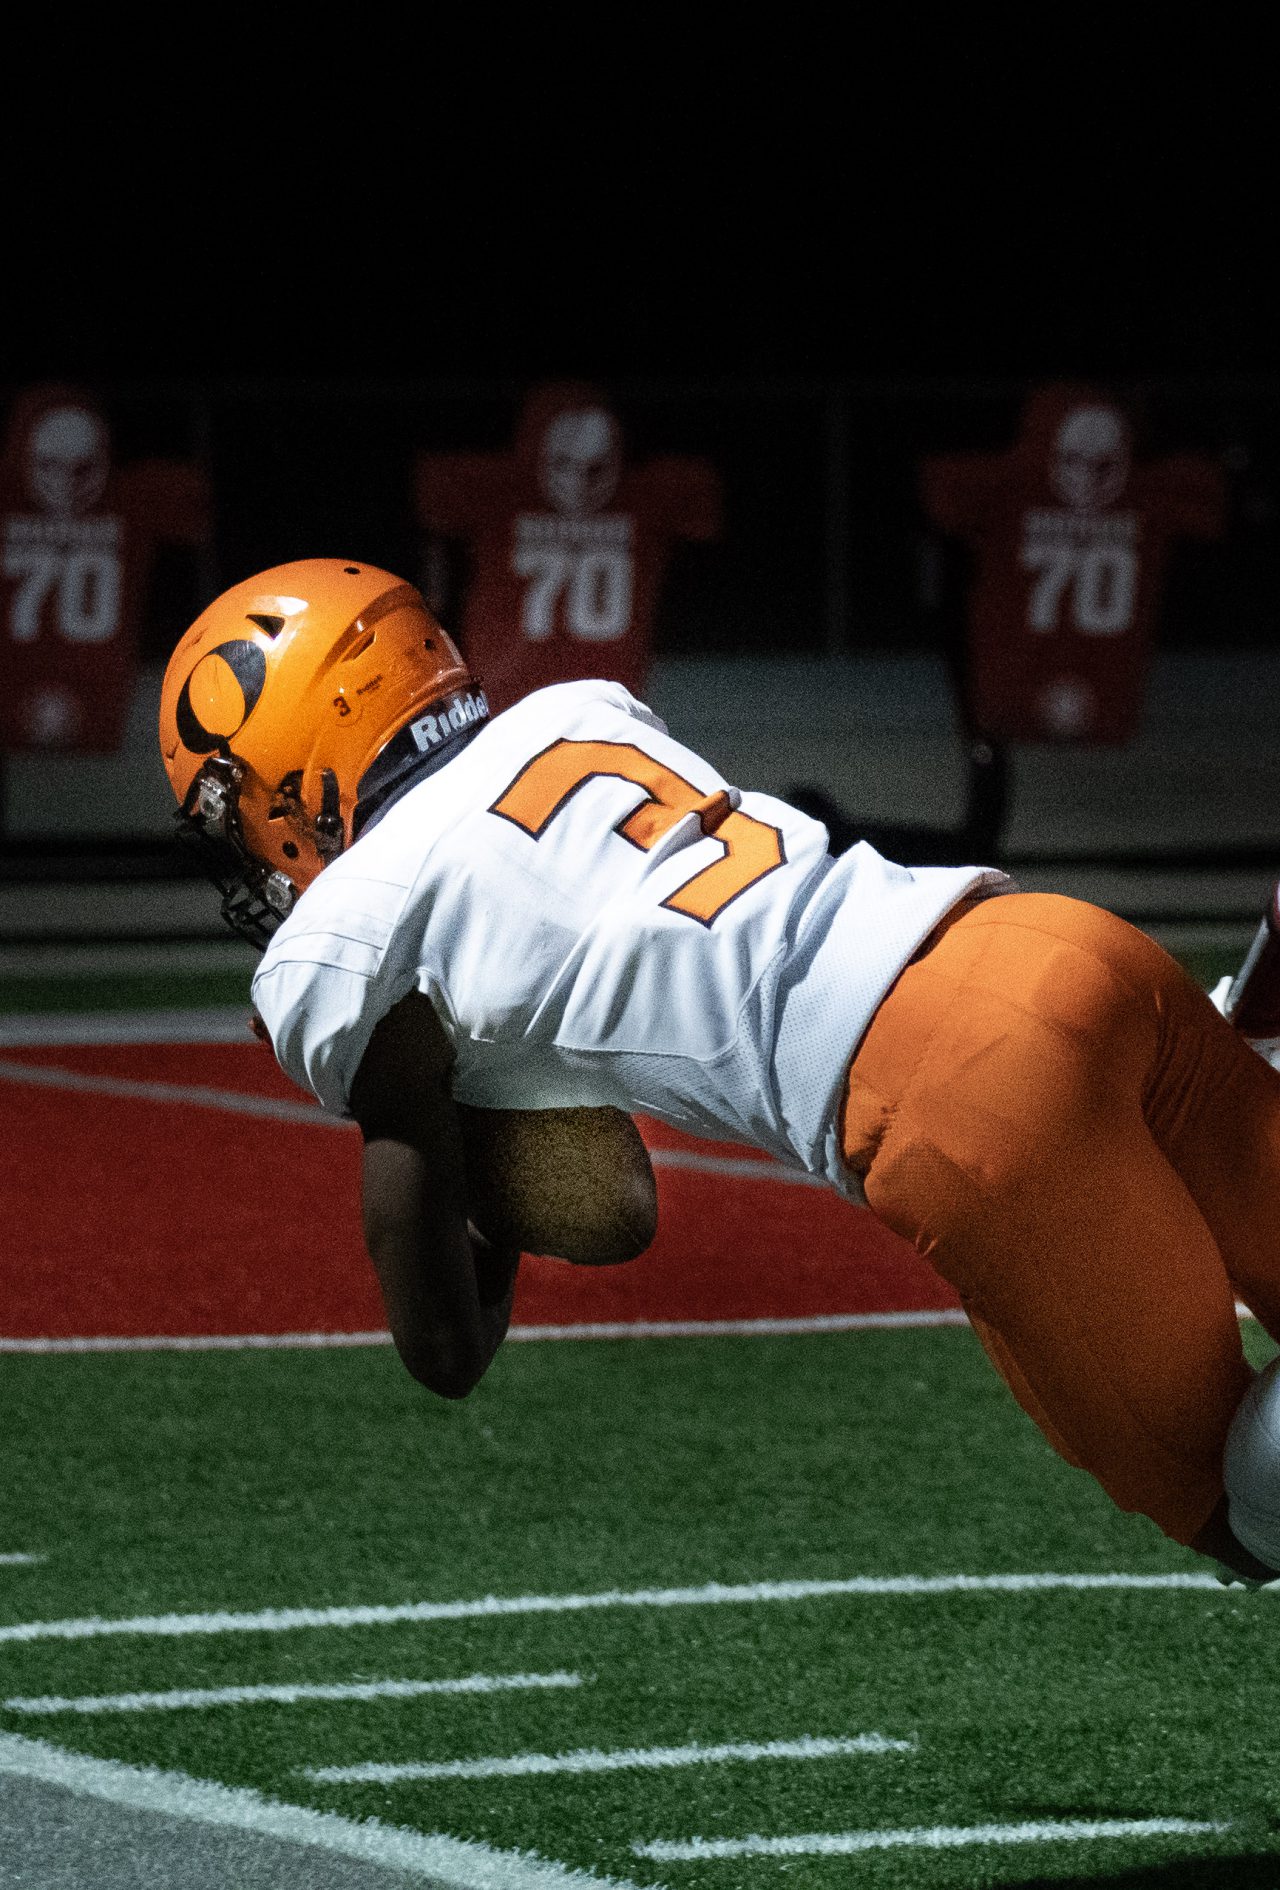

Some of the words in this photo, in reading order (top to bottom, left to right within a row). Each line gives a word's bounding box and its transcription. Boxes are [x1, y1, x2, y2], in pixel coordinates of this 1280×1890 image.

[4, 551, 121, 641] 70
[514, 552, 634, 641] 70
[1021, 548, 1139, 636] 70
[334, 696, 351, 717] 3
[487, 738, 788, 929] 3
